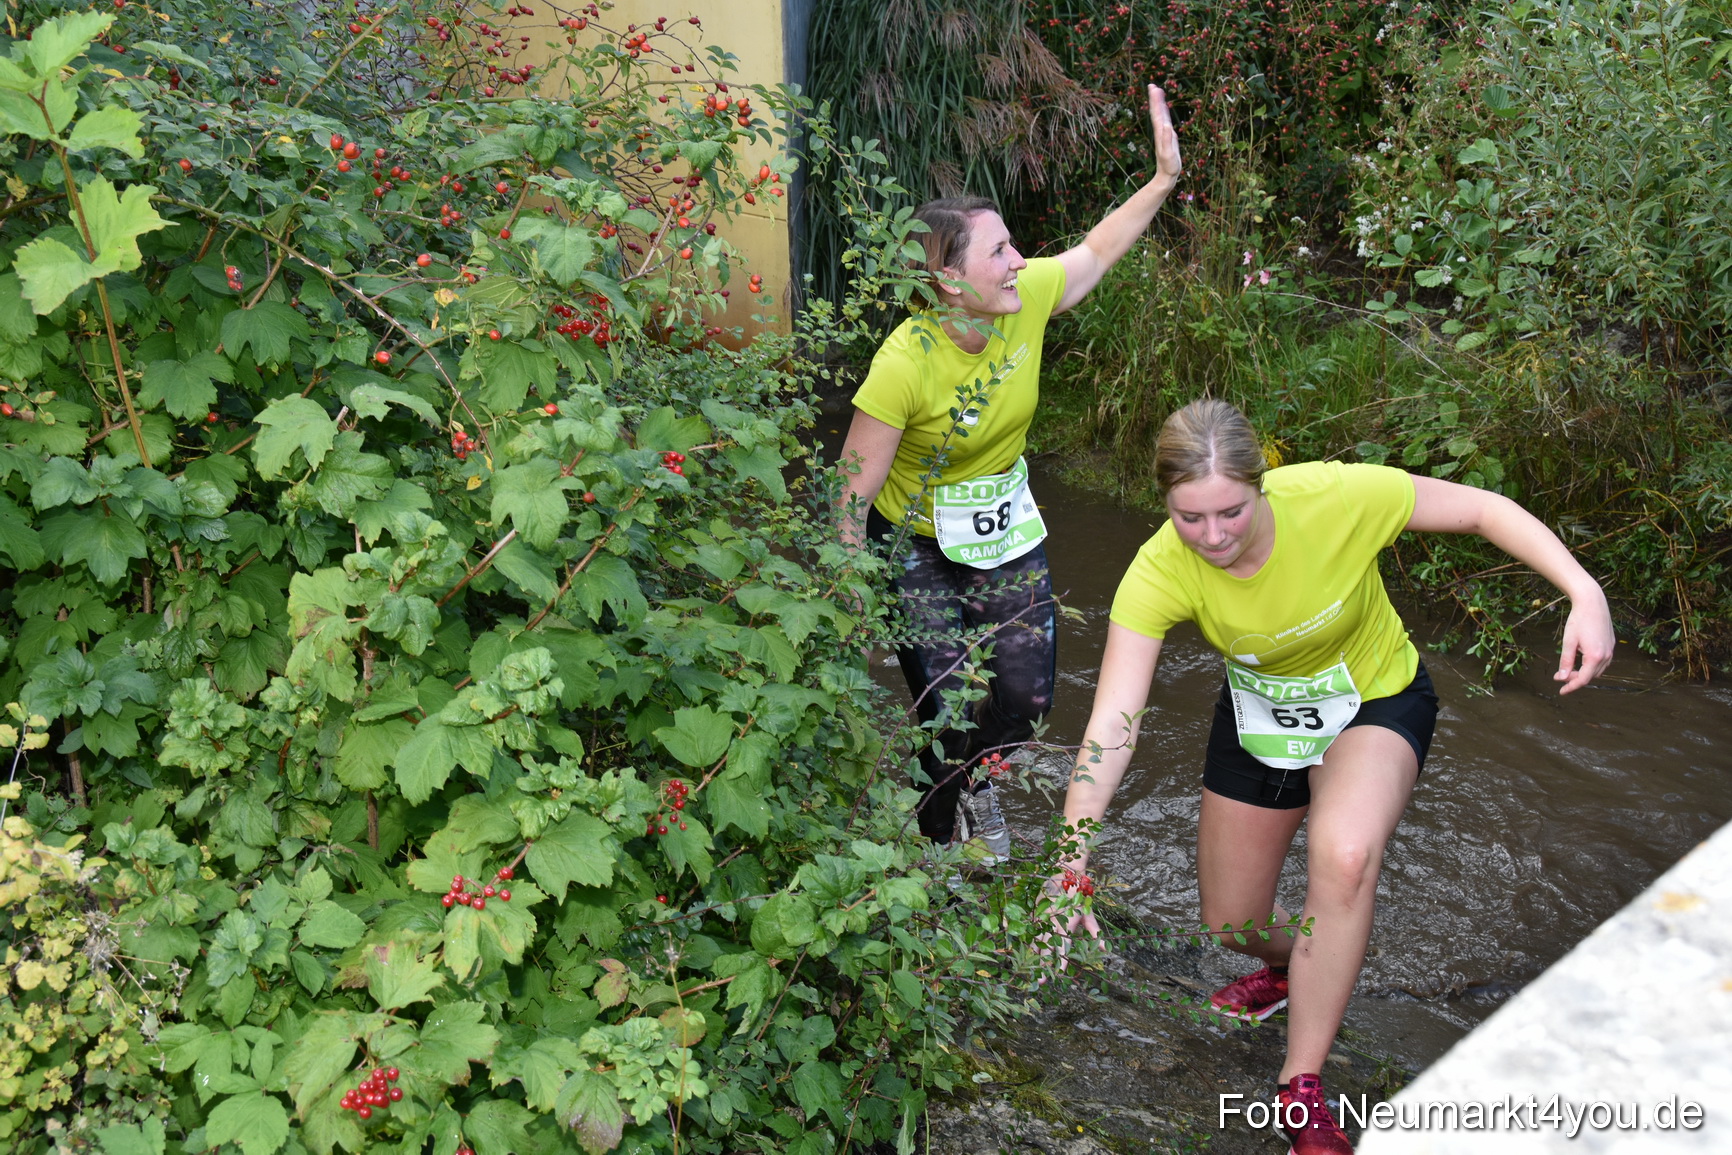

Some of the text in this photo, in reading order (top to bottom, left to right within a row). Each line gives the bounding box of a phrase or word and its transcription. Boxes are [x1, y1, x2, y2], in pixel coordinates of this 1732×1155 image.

[973, 501, 1011, 536] 68
[959, 530, 1026, 560] RAMONA
[1275, 626, 1300, 639] Kliniken
[1296, 619, 1325, 636] Neumarkt
[1271, 707, 1324, 731] 63
